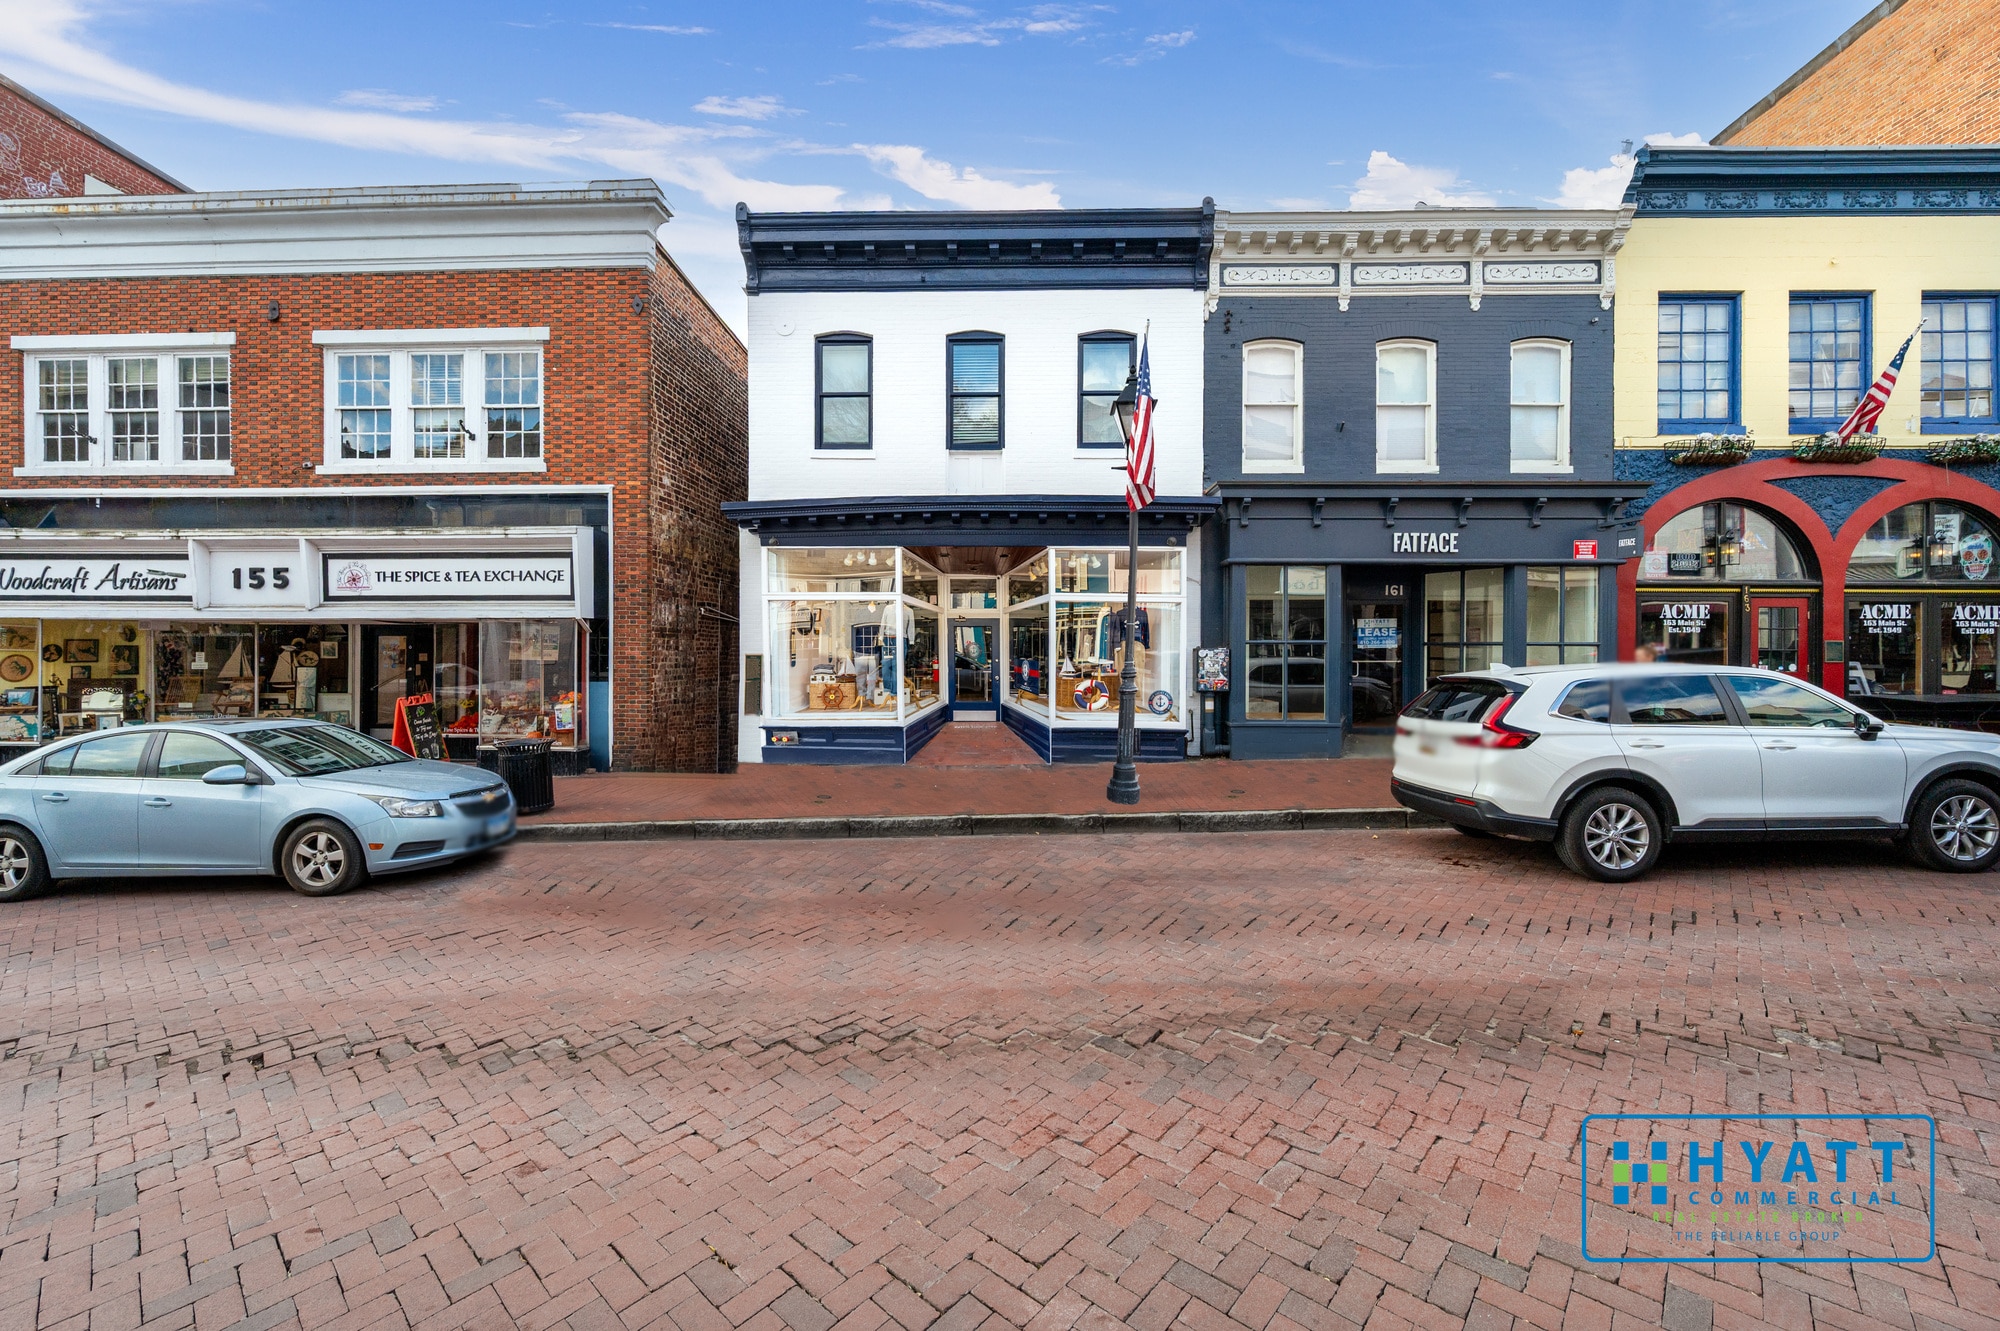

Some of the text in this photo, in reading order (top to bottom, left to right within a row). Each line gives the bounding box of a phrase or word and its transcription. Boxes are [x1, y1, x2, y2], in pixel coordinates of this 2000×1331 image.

[1393, 532, 1459, 553] FATFACE
[1618, 538, 1636, 547] FATFACE
[94, 563, 179, 590] Artisans
[232, 568, 289, 589] 155
[375, 571, 402, 583] THE
[405, 571, 441, 583] SPICE
[444, 571, 453, 582] &
[455, 570, 479, 582] TEA
[484, 570, 565, 583] EXCHANGE
[1385, 584, 1403, 596] 161
[1659, 604, 1711, 619] ACME
[1859, 604, 1912, 619] ACME
[1951, 605, 2000, 620] ACME
[1358, 627, 1397, 637] LEASE
